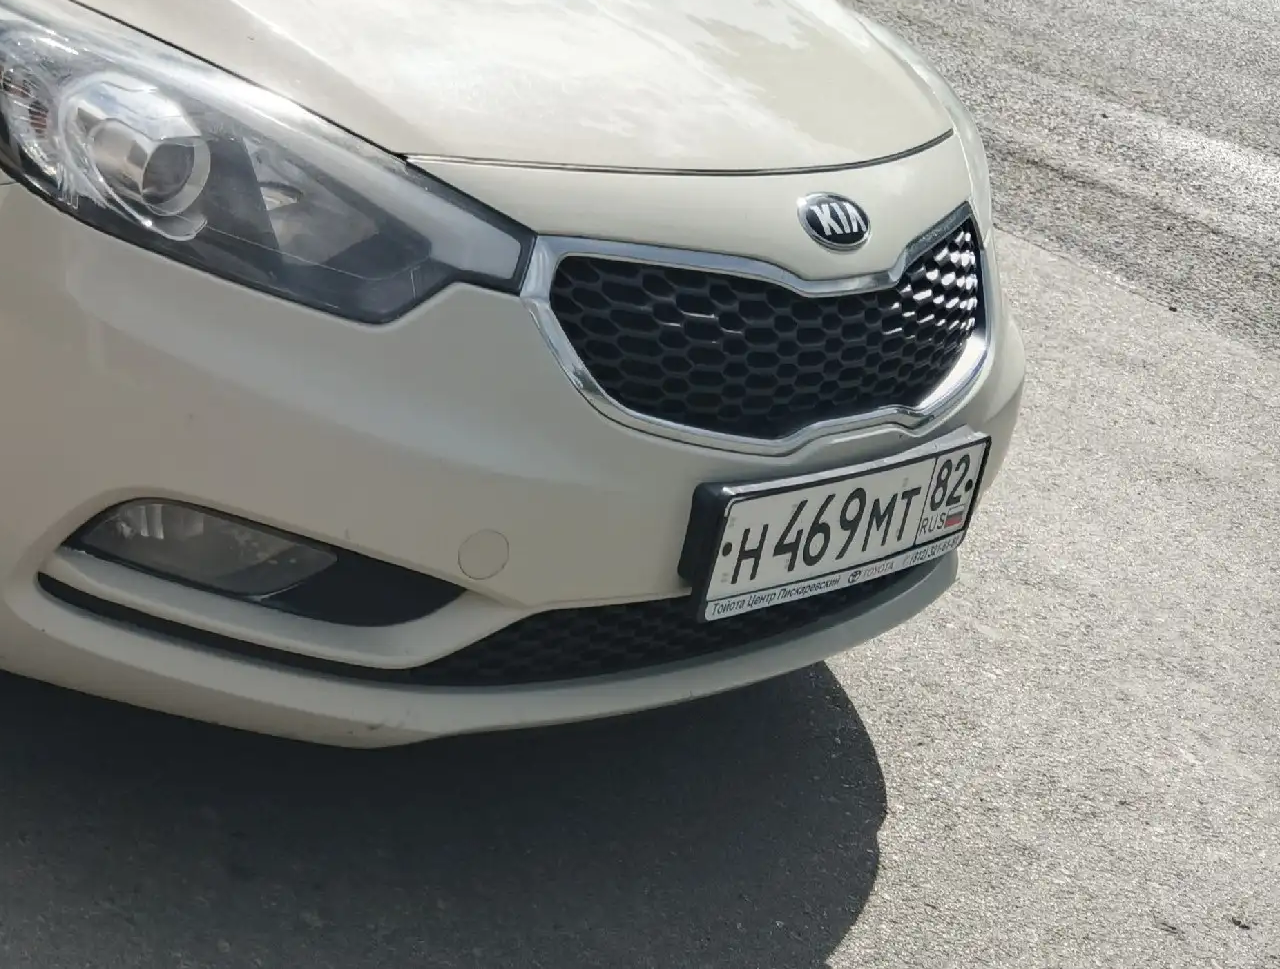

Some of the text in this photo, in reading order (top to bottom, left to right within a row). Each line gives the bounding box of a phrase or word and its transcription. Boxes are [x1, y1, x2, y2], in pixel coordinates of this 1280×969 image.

[809, 201, 867, 236] KIA
[930, 454, 971, 511] 82
[919, 512, 946, 535] RUS
[712, 598, 746, 616] Тойота
[747, 592, 777, 608] Центр
